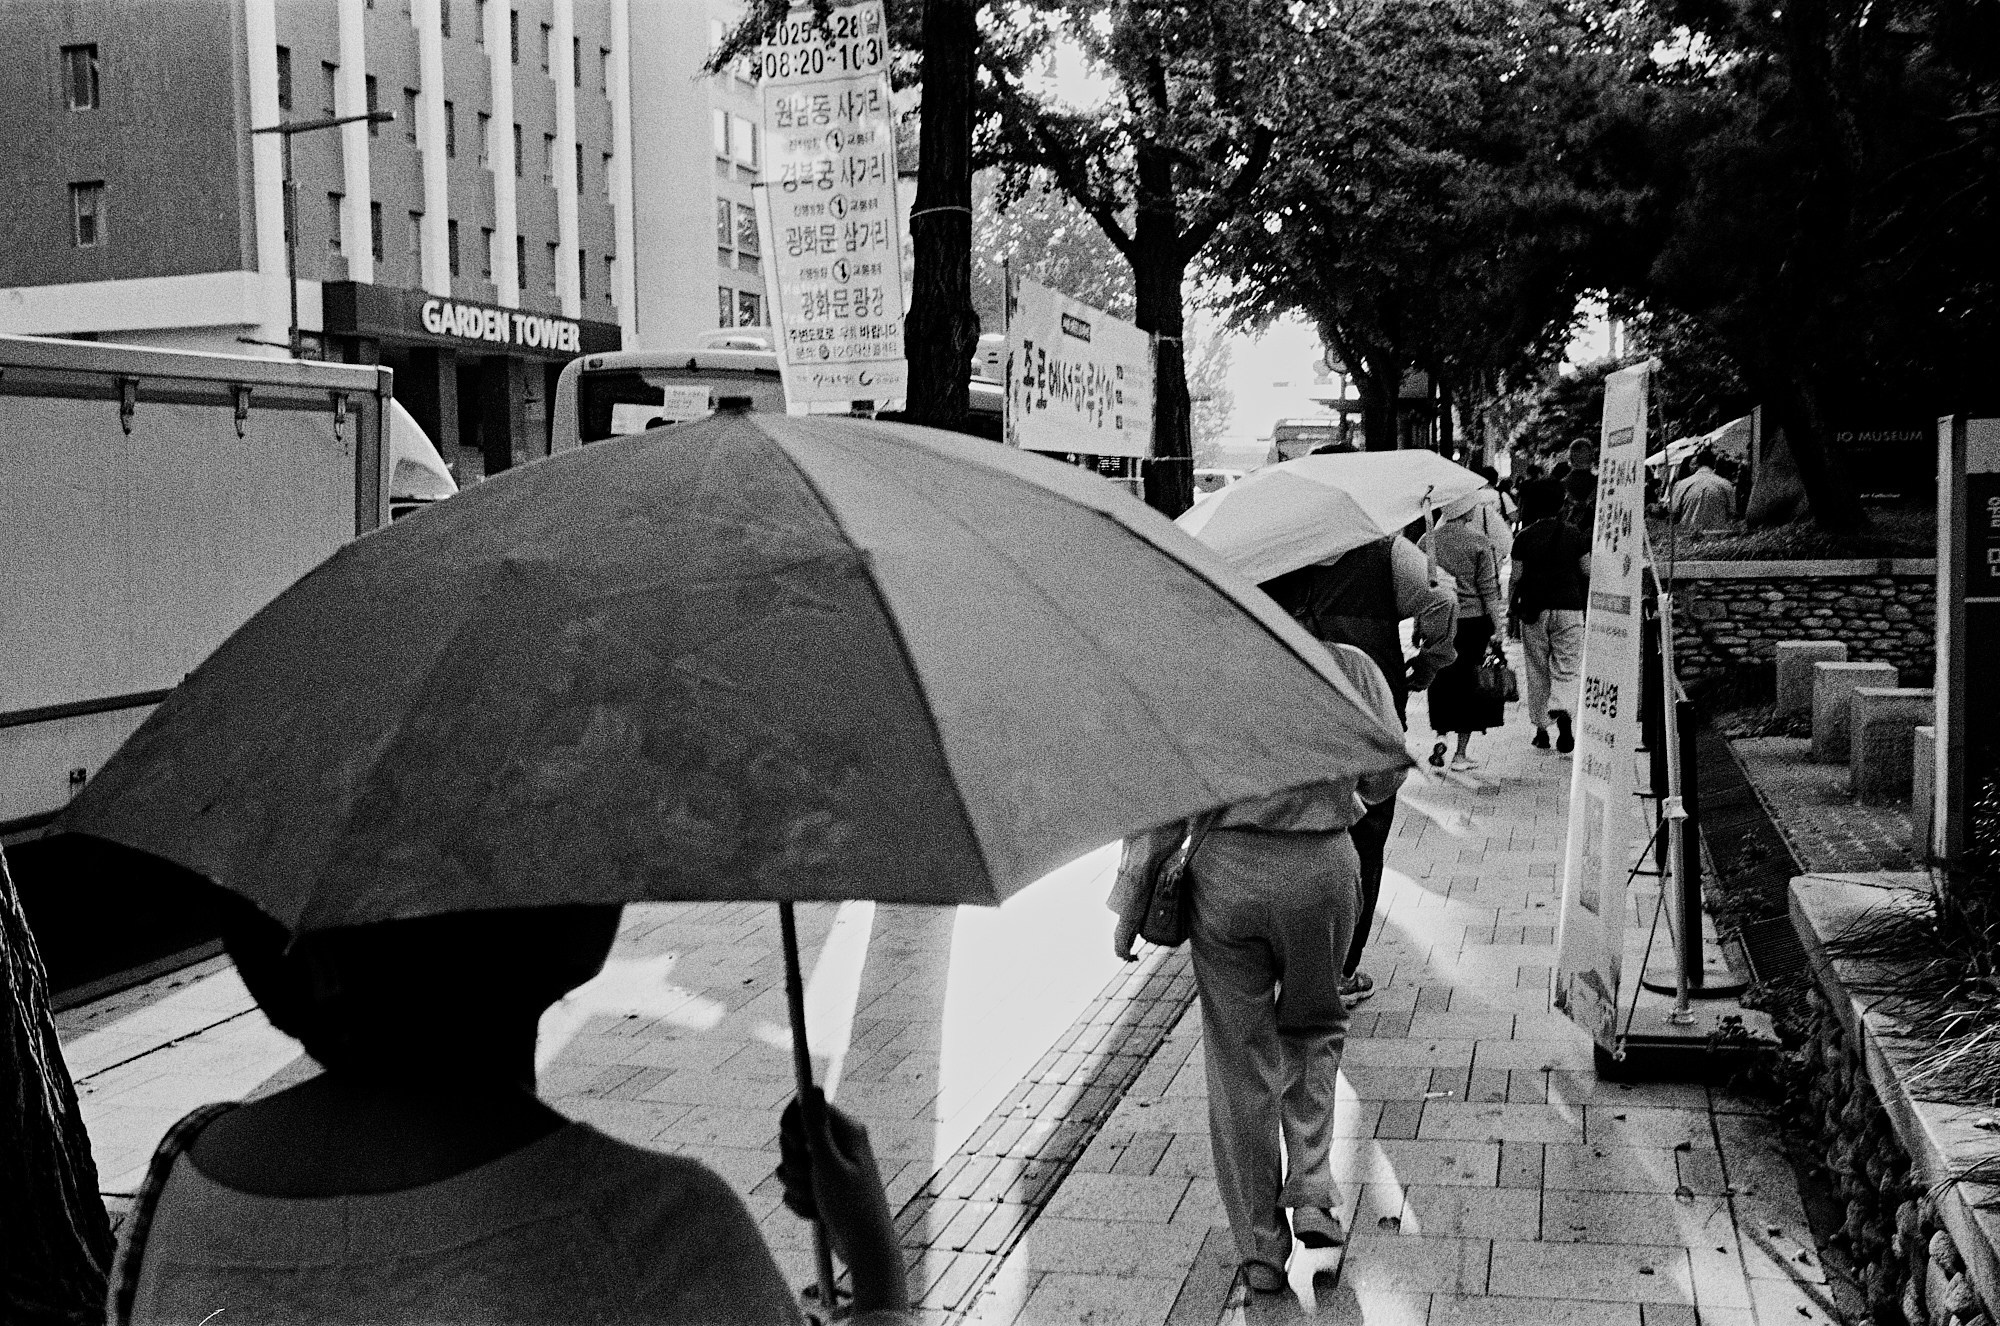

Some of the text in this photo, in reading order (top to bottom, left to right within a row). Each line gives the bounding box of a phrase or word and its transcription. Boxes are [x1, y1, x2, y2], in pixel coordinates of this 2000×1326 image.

[786, 217, 888, 257] 광화문 삼거리
[421, 299, 582, 353] GARDEN TOWER
[1858, 431, 1923, 442] MUSEUM
